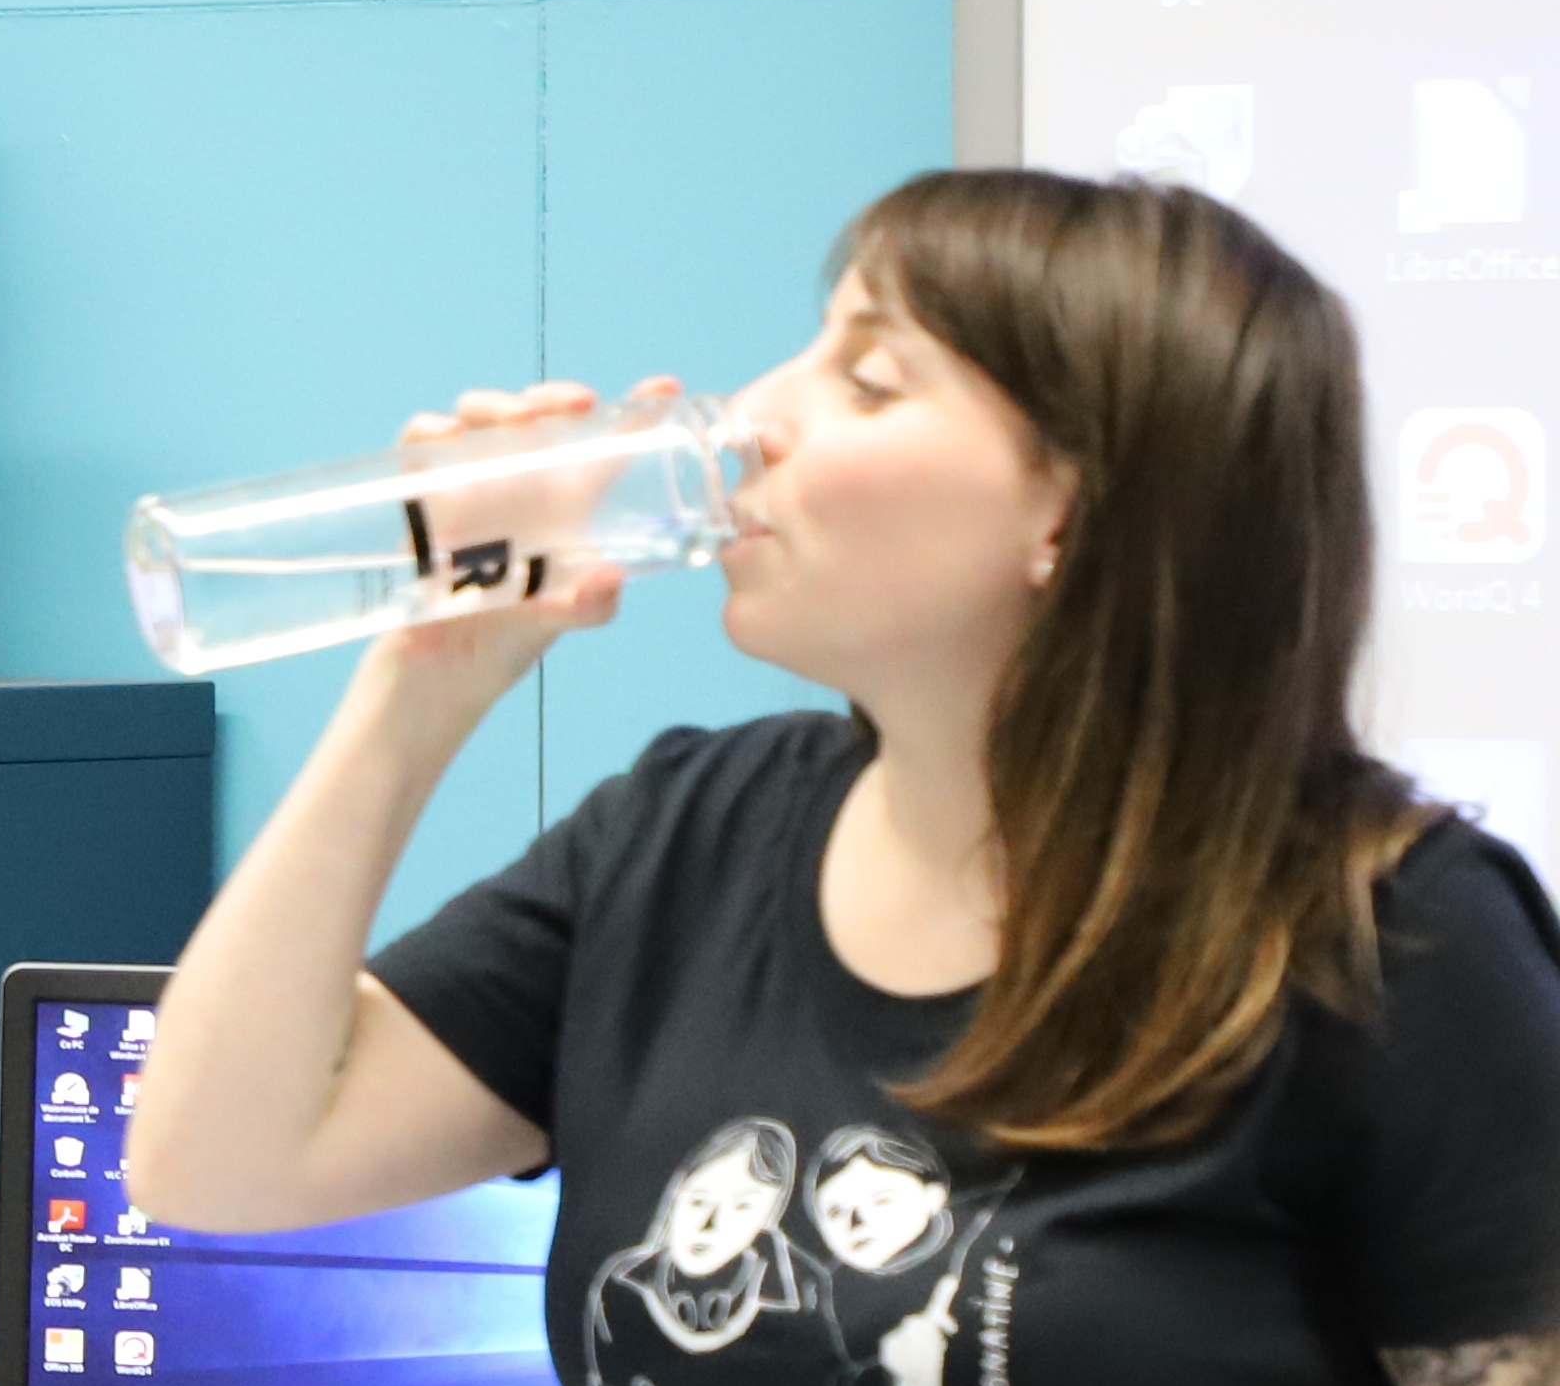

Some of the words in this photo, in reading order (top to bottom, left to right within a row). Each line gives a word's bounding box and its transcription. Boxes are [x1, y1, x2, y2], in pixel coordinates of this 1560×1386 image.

[1385, 247, 1560, 282] LibreOffice
[1397, 579, 1515, 614] WordQ
[1520, 580, 1543, 609] 4
